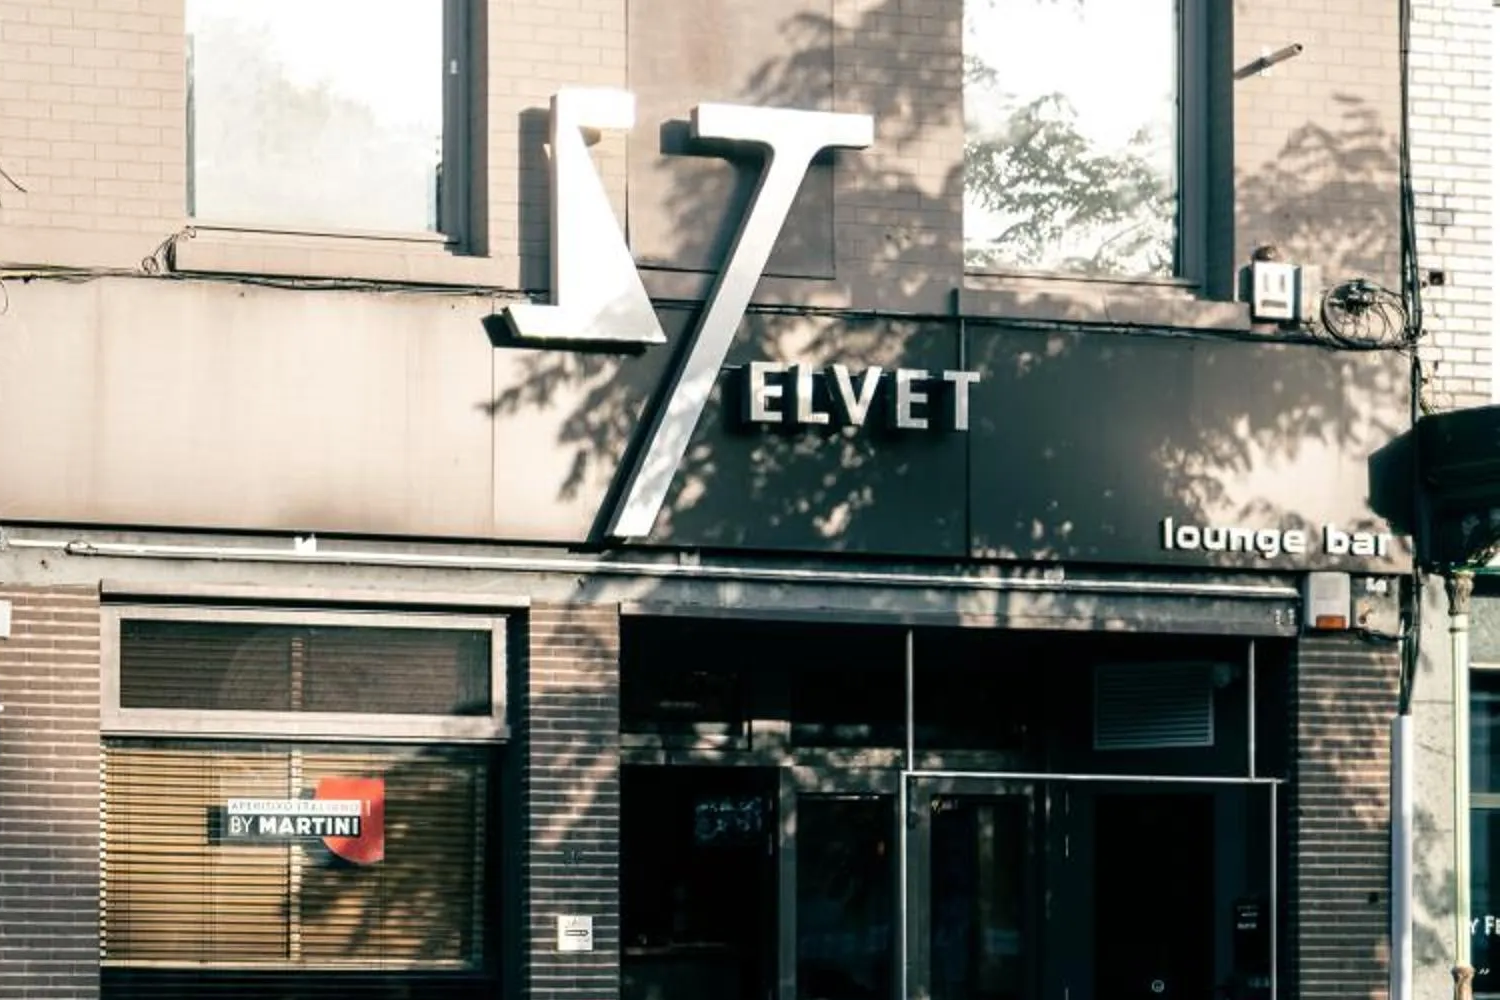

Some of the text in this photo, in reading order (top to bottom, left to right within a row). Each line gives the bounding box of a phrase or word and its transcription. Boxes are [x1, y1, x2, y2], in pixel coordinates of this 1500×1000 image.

[1162, 515, 1393, 560] lounge bar
[230, 816, 360, 836] BY MARTINI
